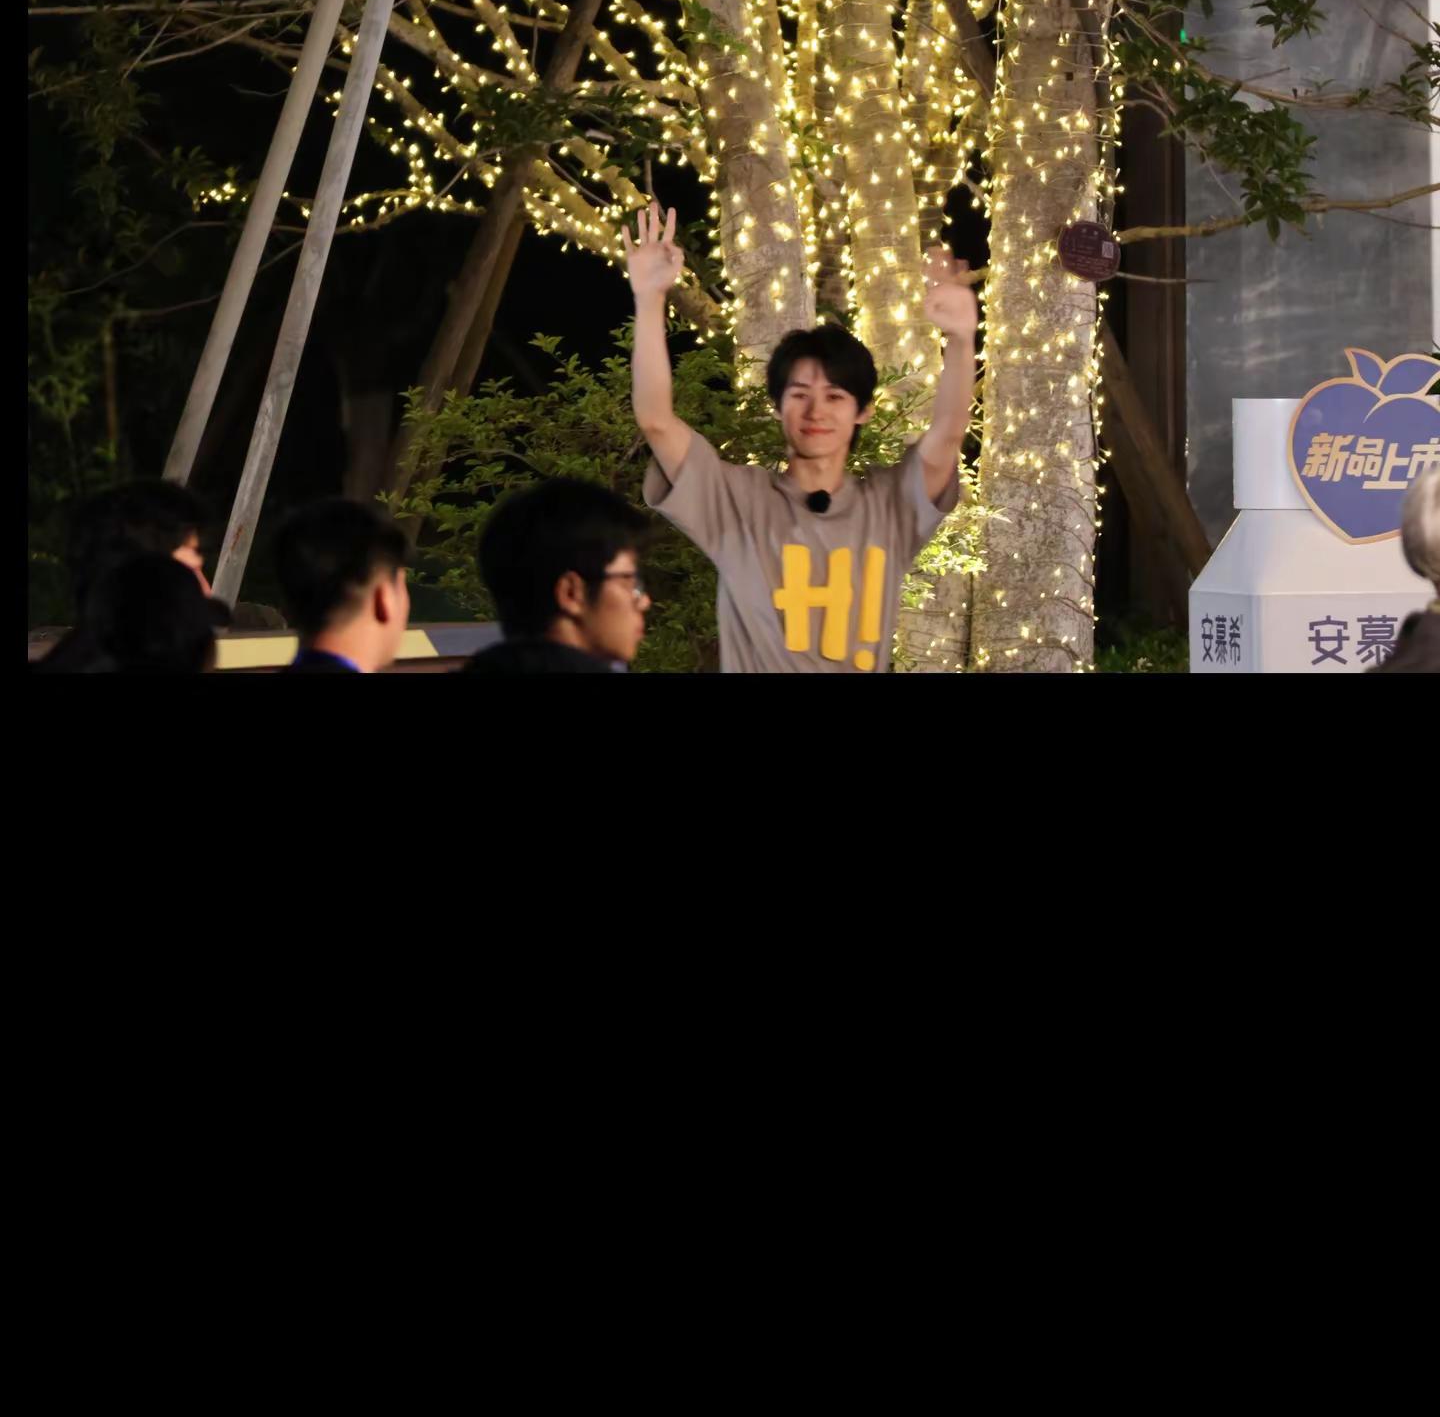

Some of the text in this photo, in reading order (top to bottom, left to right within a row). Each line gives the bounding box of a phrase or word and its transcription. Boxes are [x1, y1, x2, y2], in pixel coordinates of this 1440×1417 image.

[773, 543, 886, 671] H!
[1201, 613, 1242, 666] 安慕希
